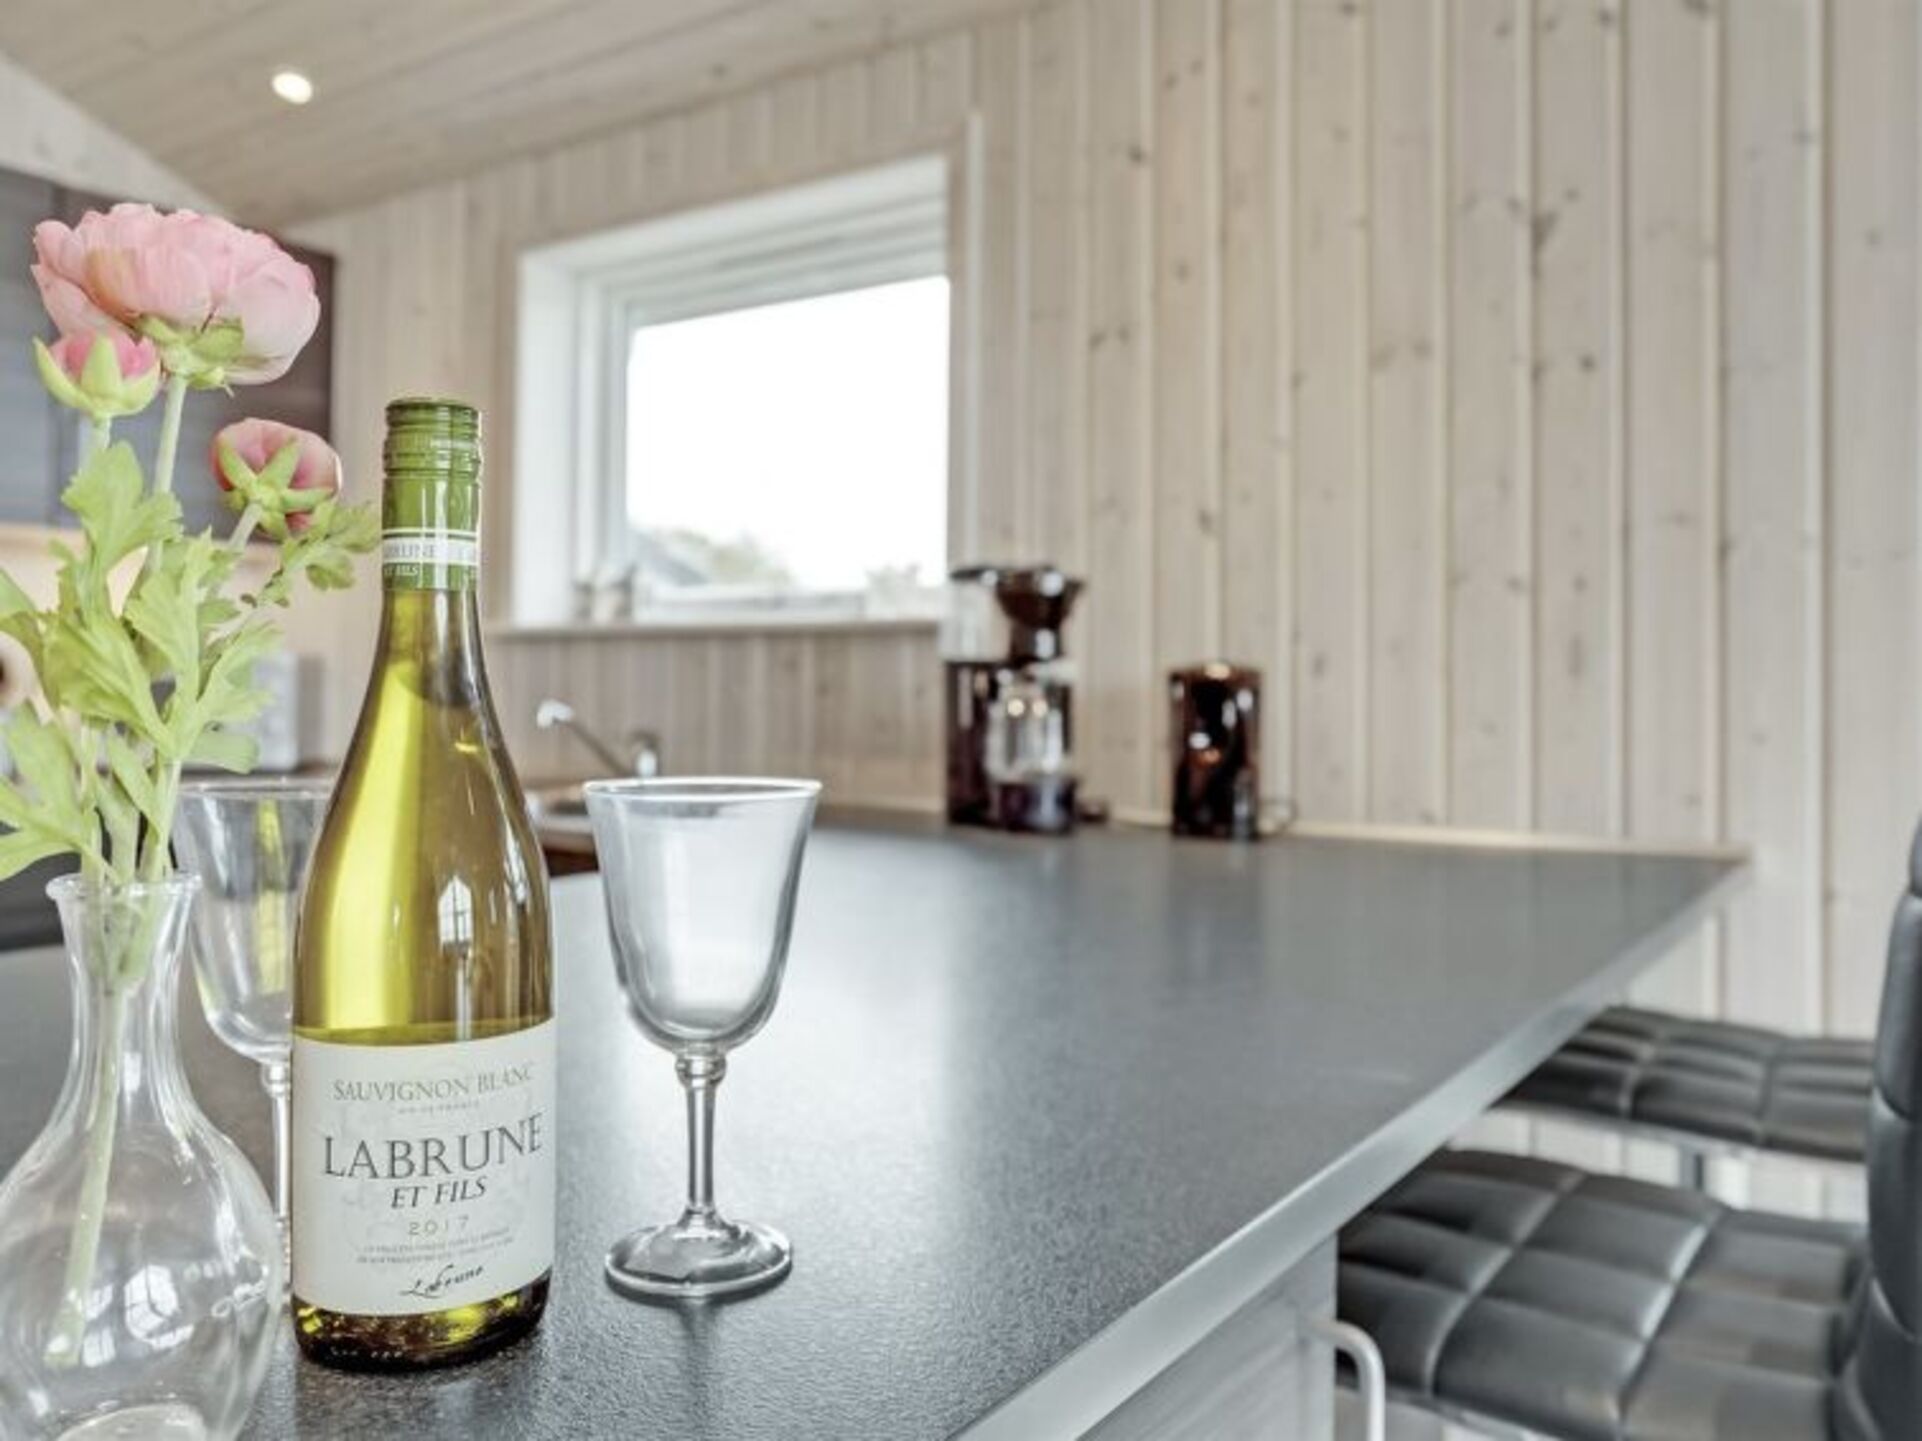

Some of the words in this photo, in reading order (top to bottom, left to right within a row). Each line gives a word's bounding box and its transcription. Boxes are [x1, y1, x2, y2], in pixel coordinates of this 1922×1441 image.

[333, 1078, 470, 1101] SAUVIGNON
[477, 1063, 533, 1093] BLANC
[323, 1112, 544, 1179] LABRUNE
[391, 1186, 427, 1209] ET
[434, 1175, 488, 1205] FILS
[408, 1214, 469, 1236] 2017
